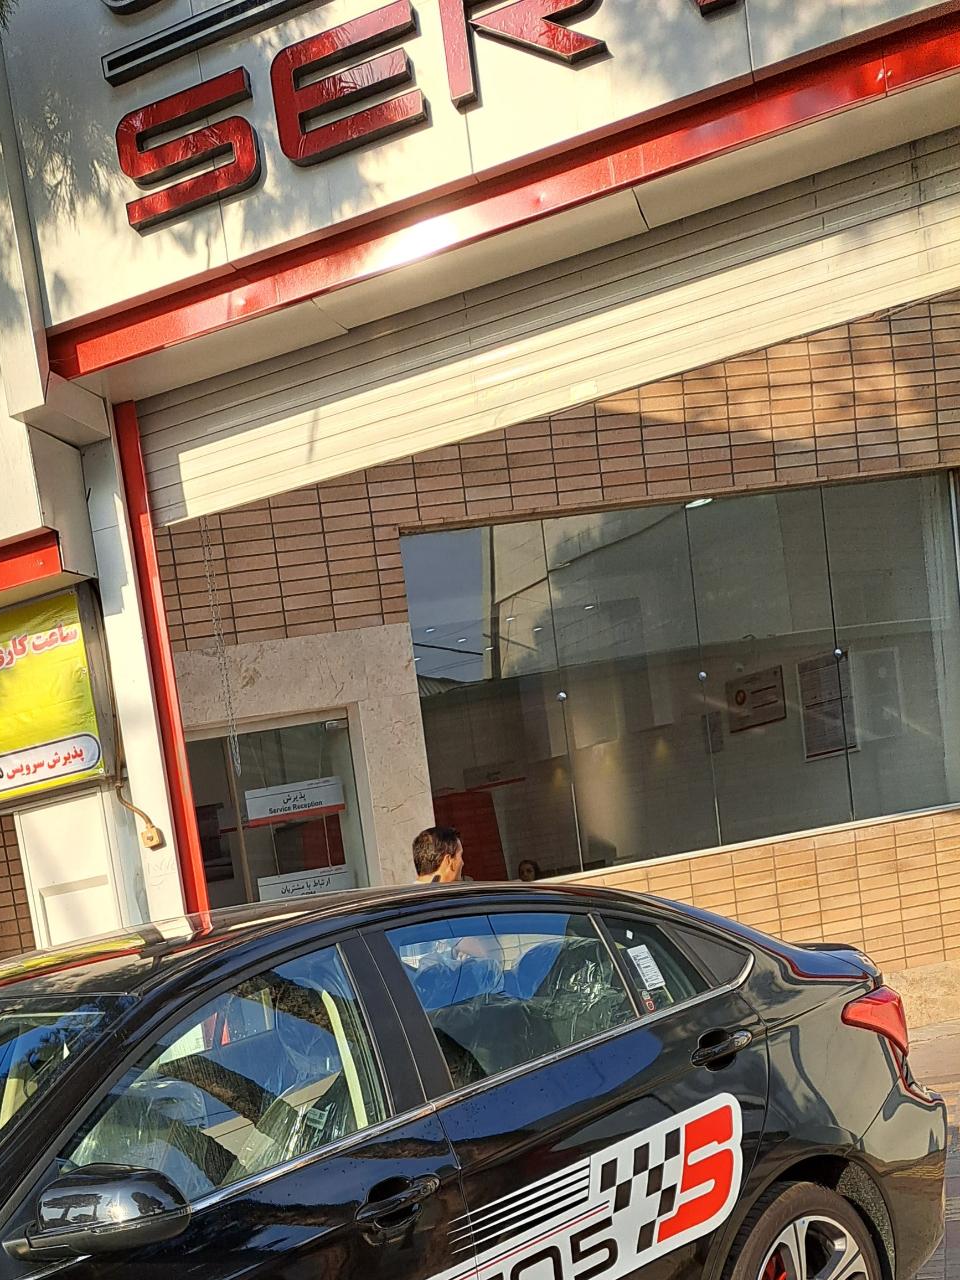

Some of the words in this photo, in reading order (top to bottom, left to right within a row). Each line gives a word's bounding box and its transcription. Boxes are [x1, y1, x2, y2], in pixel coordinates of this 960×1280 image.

[115, 0, 742, 234] SER
[31, 623, 79, 652] ساعت
[6, 759, 45, 780] سرویس
[47, 745, 85, 770] پذیرش
[268, 804, 292, 815] Service
[292, 800, 323, 811] Reception
